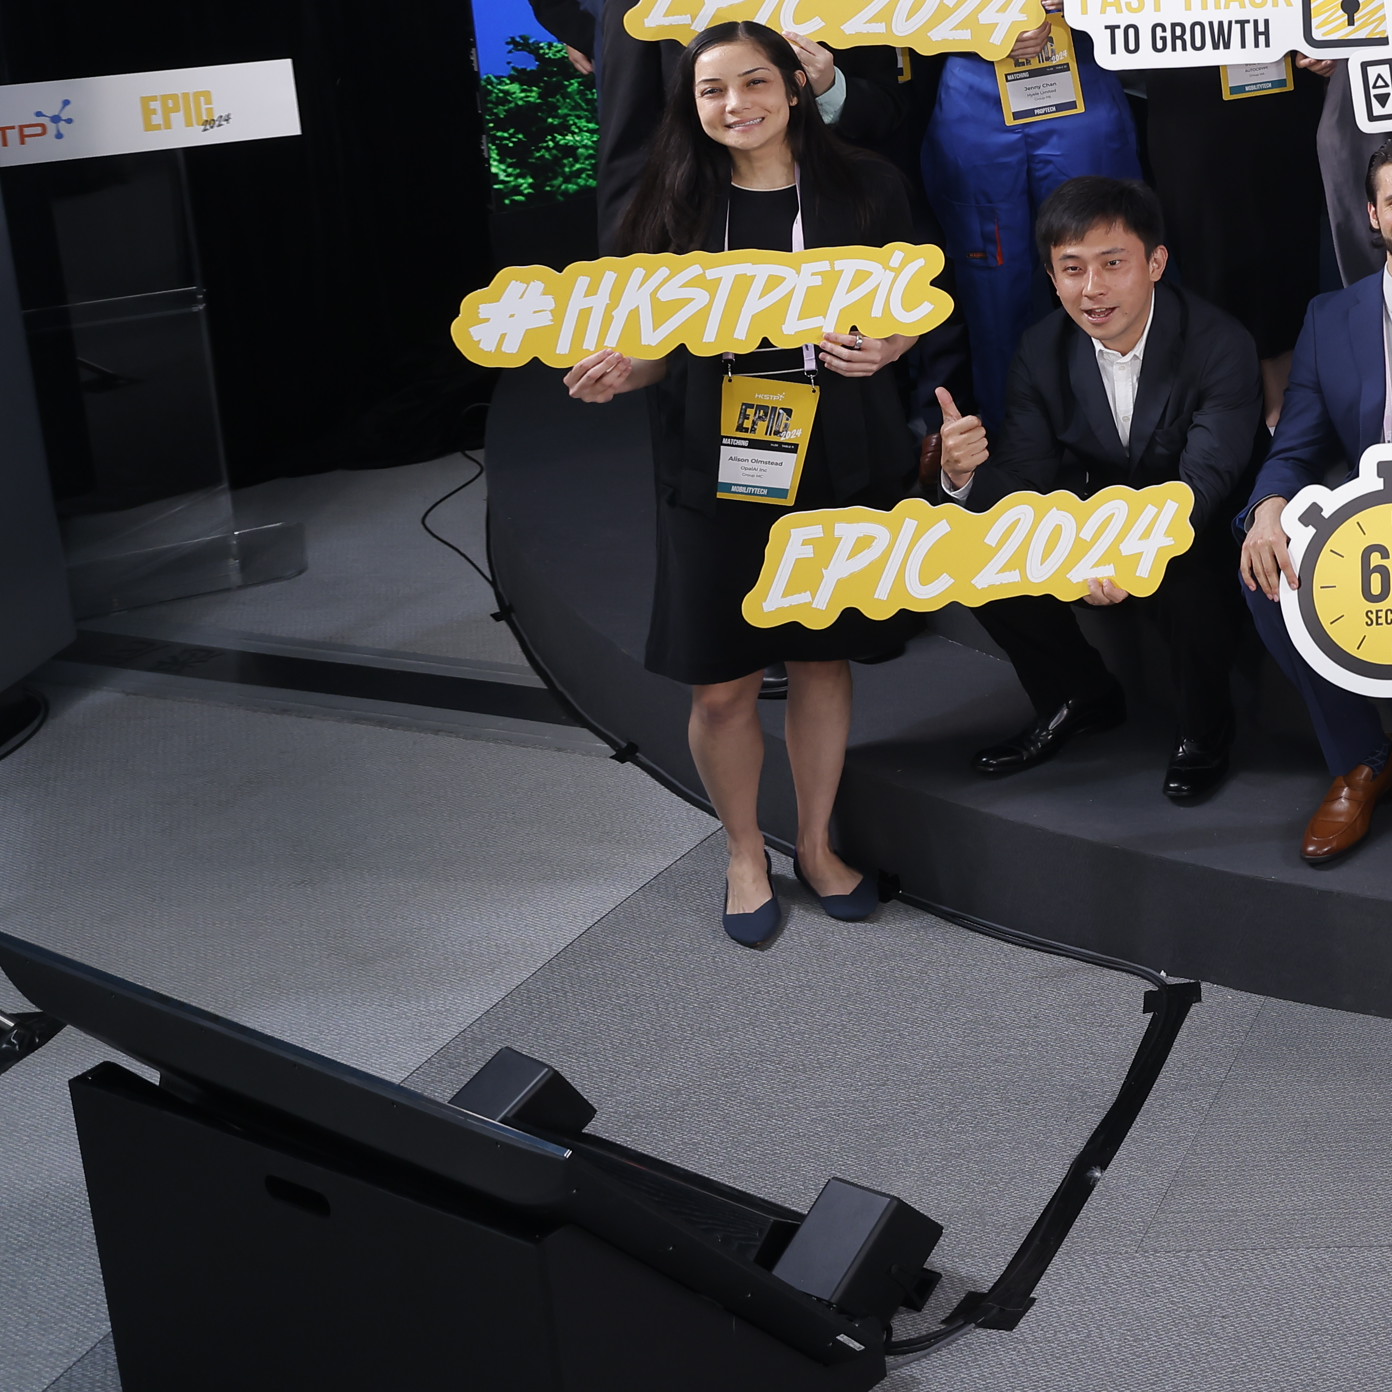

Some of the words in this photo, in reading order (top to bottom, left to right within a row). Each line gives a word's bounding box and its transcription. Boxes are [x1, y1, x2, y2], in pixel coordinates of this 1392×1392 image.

[1104, 22, 1142, 55] TO
[1150, 18, 1272, 54] GROWTH
[1007, 71, 1030, 81] MATCHING
[1024, 84, 1041, 92] Jenny
[1041, 81, 1057, 89] Chan
[139, 89, 215, 133] EPIC
[1034, 106, 1057, 116] PROPTECH
[201, 112, 232, 133] 2024
[735, 402, 793, 438] EPIC
[780, 428, 803, 441] 2024
[722, 437, 749, 447] MATCHING
[728, 455, 749, 463] Alison
[750, 458, 784, 467] Olmstead
[730, 485, 768, 496] MOBILITYTECH
[762, 518, 954, 612] EPIC
[971, 497, 1178, 589] 2024
